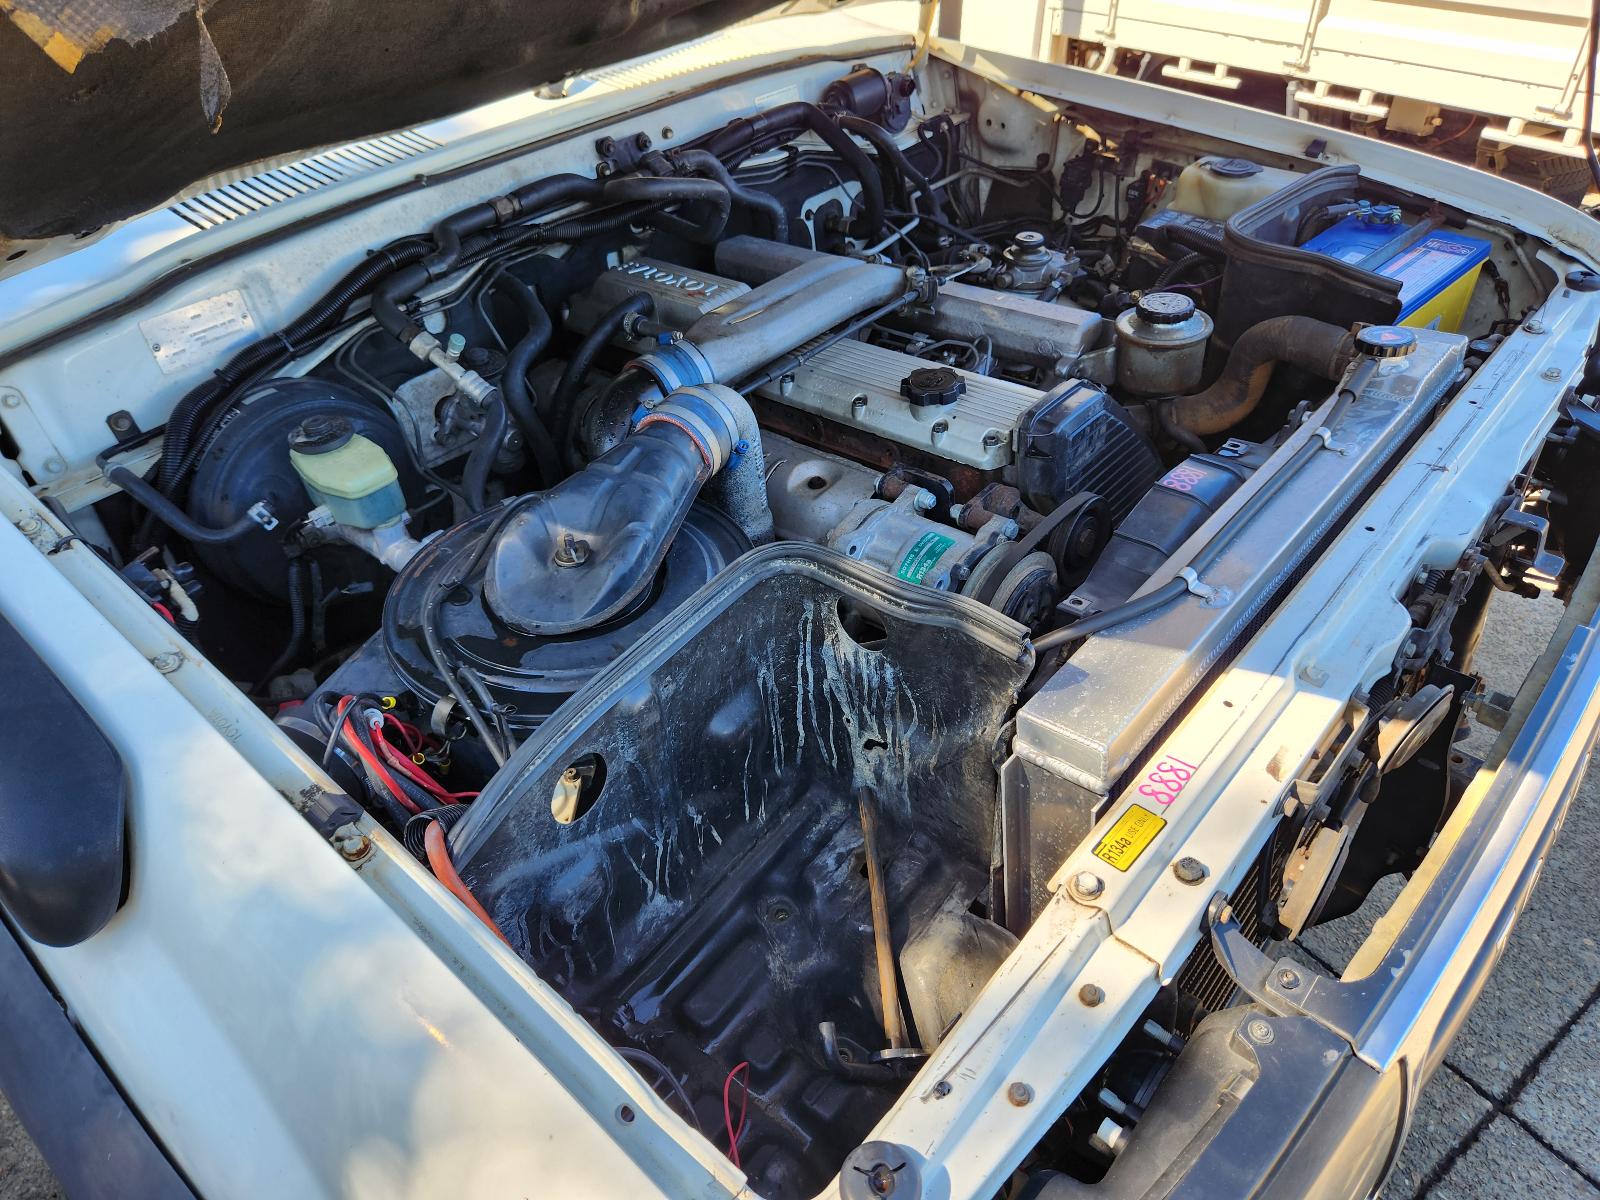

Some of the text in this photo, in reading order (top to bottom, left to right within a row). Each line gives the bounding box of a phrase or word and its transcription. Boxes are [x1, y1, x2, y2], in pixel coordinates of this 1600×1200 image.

[617, 261, 719, 297] TOYOTA
[1101, 837, 1132, 864] R134a
[1127, 823, 1140, 839] USE
